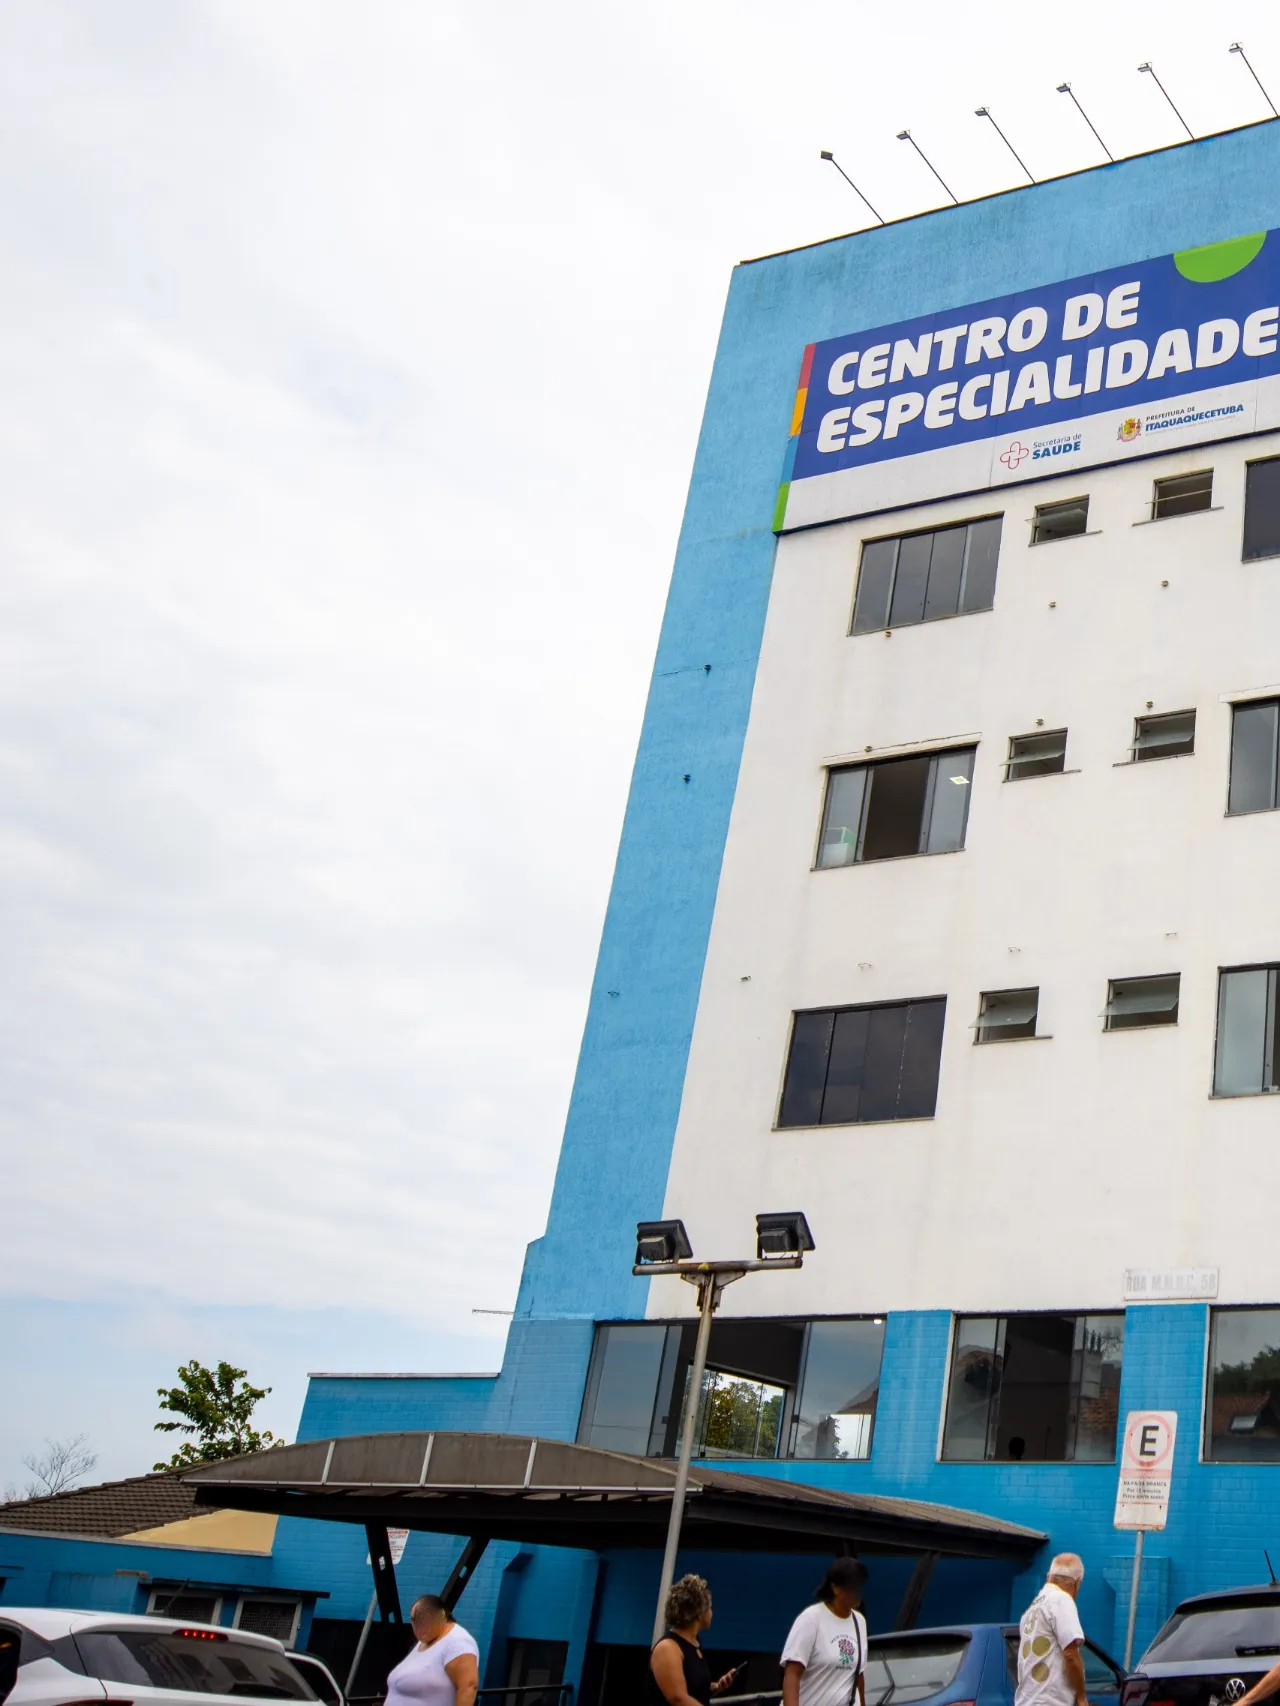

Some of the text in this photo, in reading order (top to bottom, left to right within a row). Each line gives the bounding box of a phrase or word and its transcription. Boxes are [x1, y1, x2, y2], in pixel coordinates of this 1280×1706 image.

[827, 281, 1141, 396] CENTRO DE
[1145, 403, 1245, 432] ITAQUAQUECETUBA
[1146, 405, 1196, 422] PREFEITURA DE
[1033, 433, 1082, 449] Secretaria de
[1126, 1275, 1147, 1292] RUA
[1139, 1425, 1160, 1456] E
